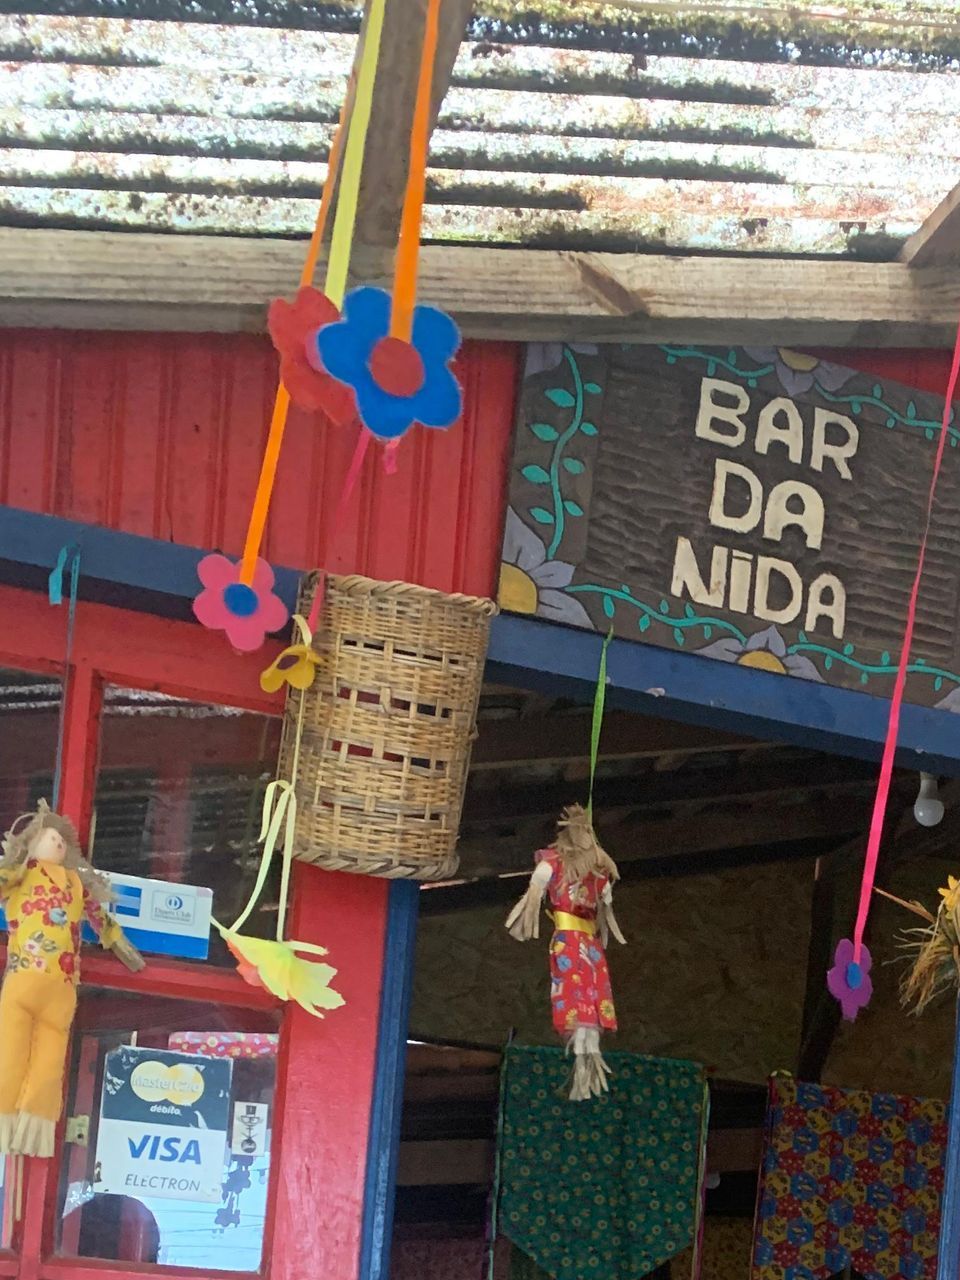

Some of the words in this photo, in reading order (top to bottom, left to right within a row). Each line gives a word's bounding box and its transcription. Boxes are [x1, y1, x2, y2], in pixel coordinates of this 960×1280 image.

[695, 376, 859, 480] BAR
[709, 458, 826, 550] DA
[127, 1134, 202, 1165] VISA
[124, 1173, 201, 1192] ELECTRON
